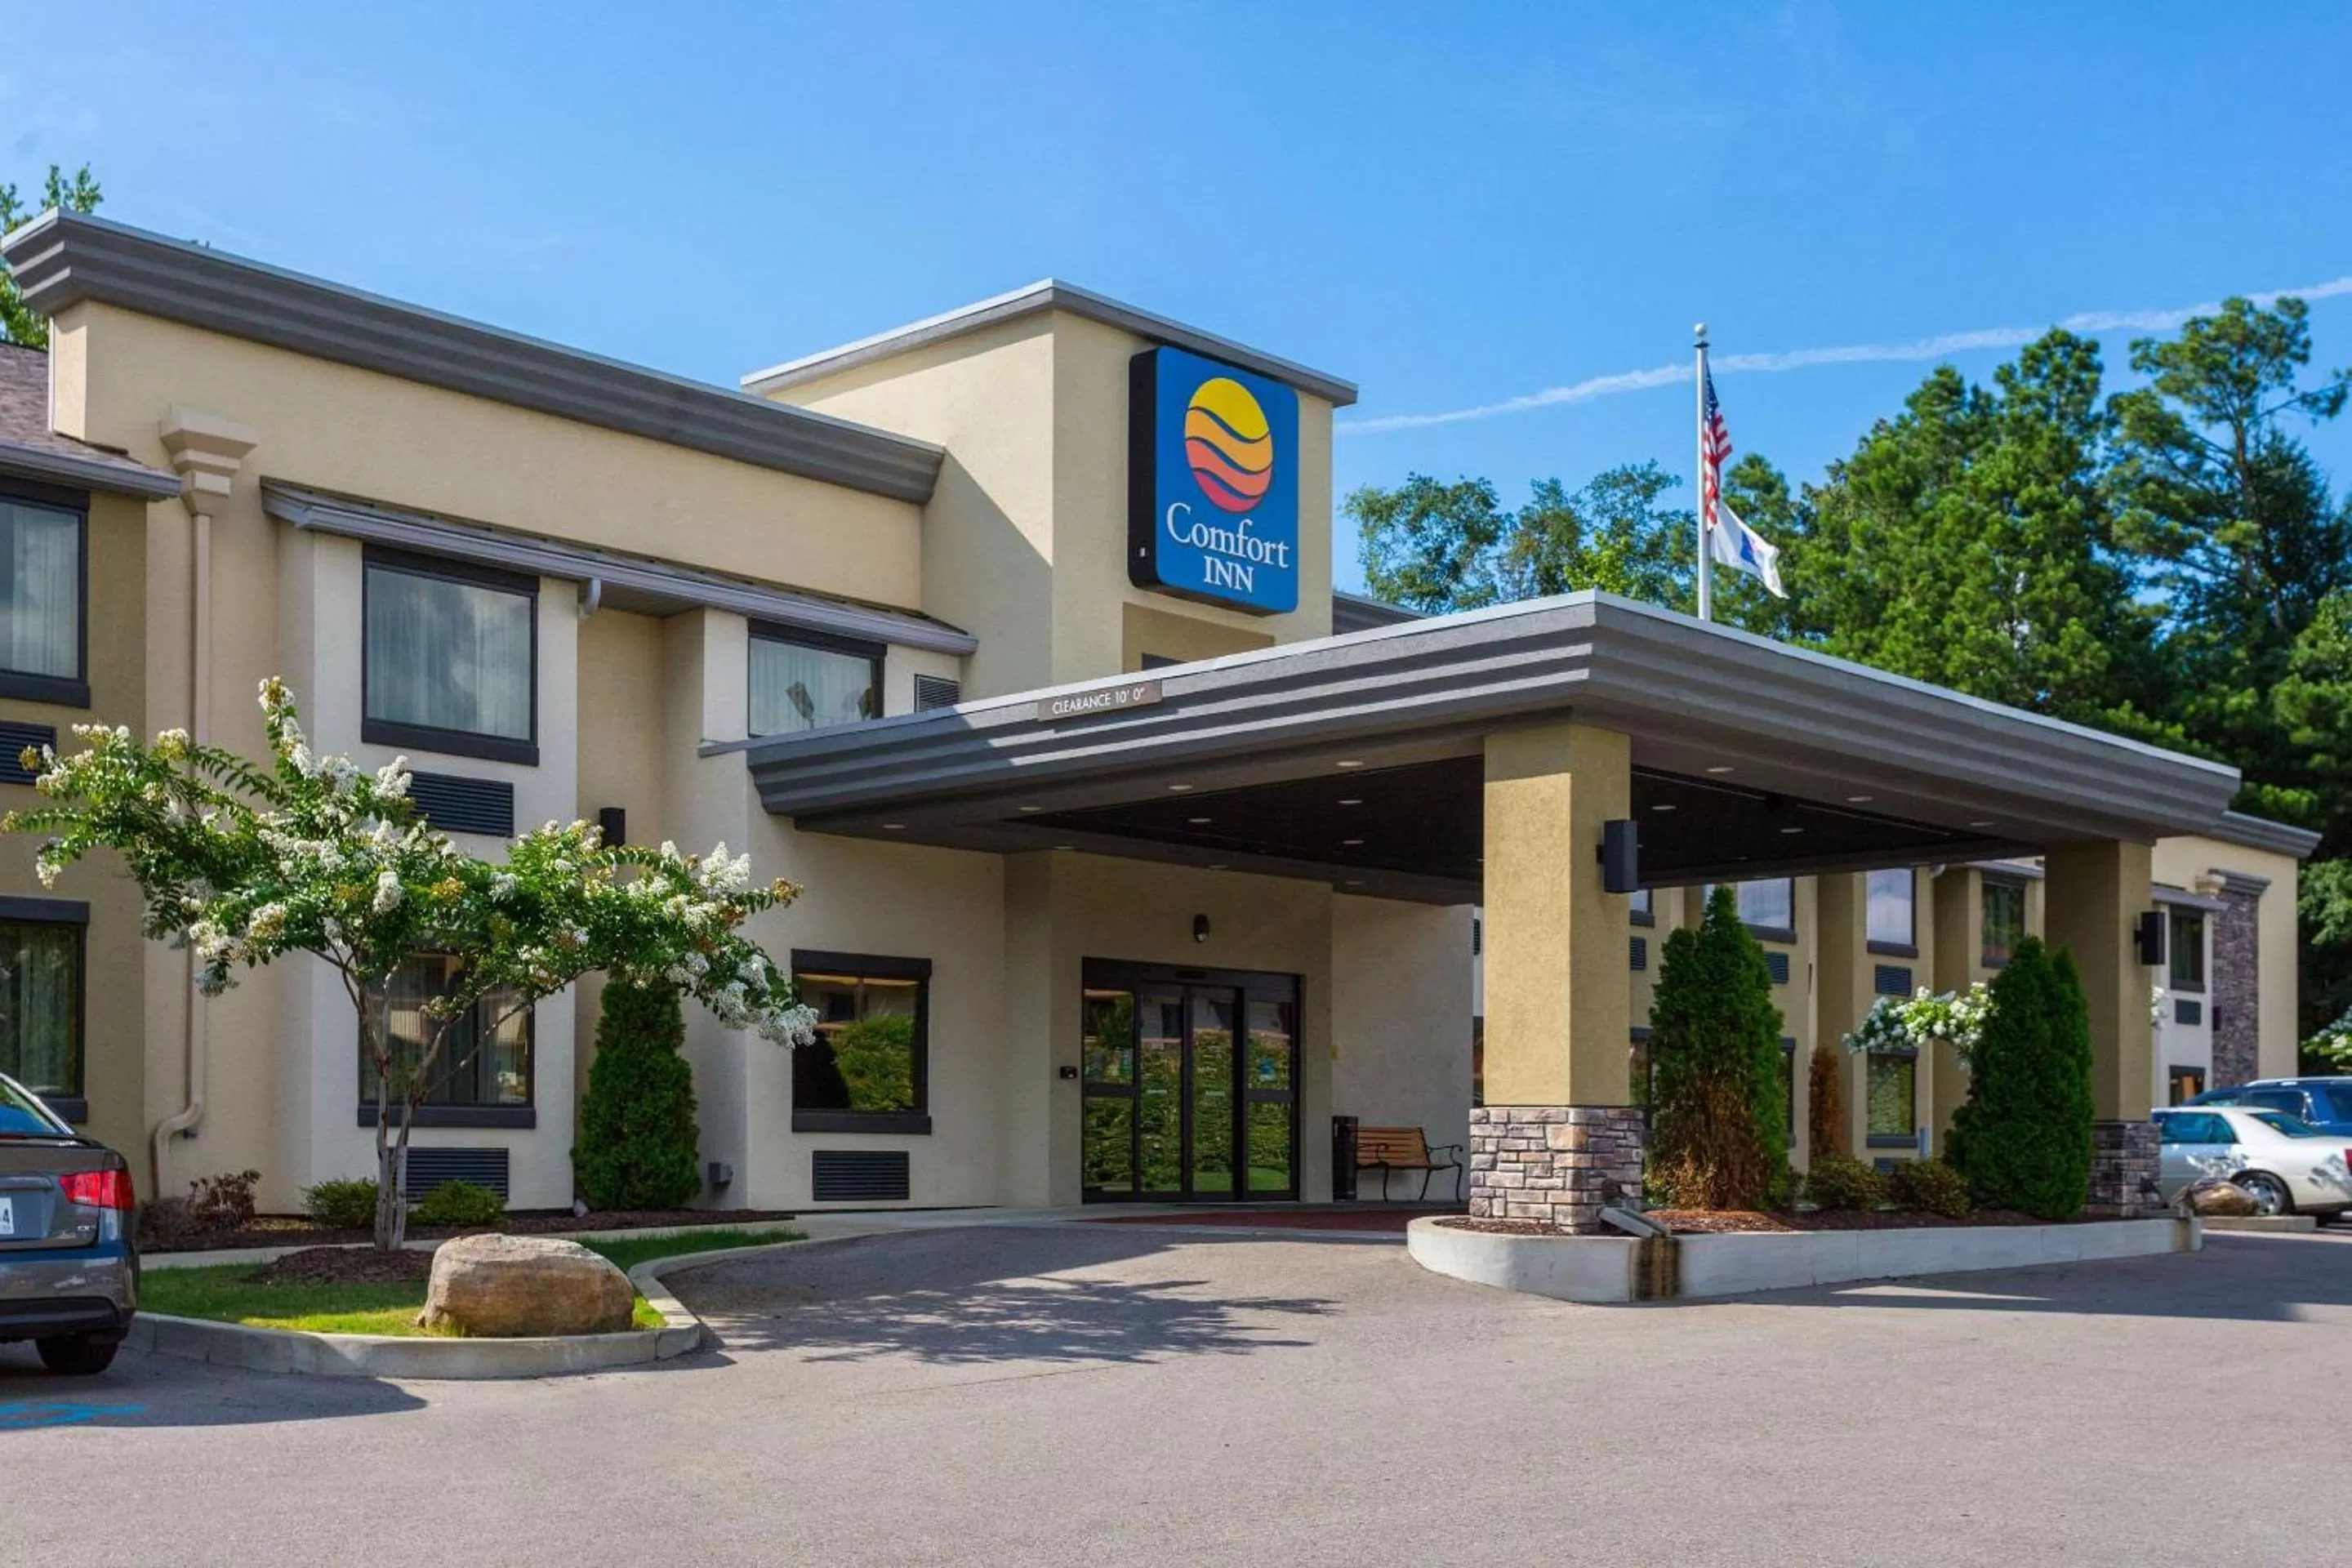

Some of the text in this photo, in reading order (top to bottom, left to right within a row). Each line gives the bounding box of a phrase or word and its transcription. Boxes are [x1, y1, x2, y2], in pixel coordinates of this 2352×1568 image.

[1166, 501, 1290, 568] Comfort
[1204, 555, 1254, 594] INN
[1052, 693, 1111, 715] CLEARANCE
